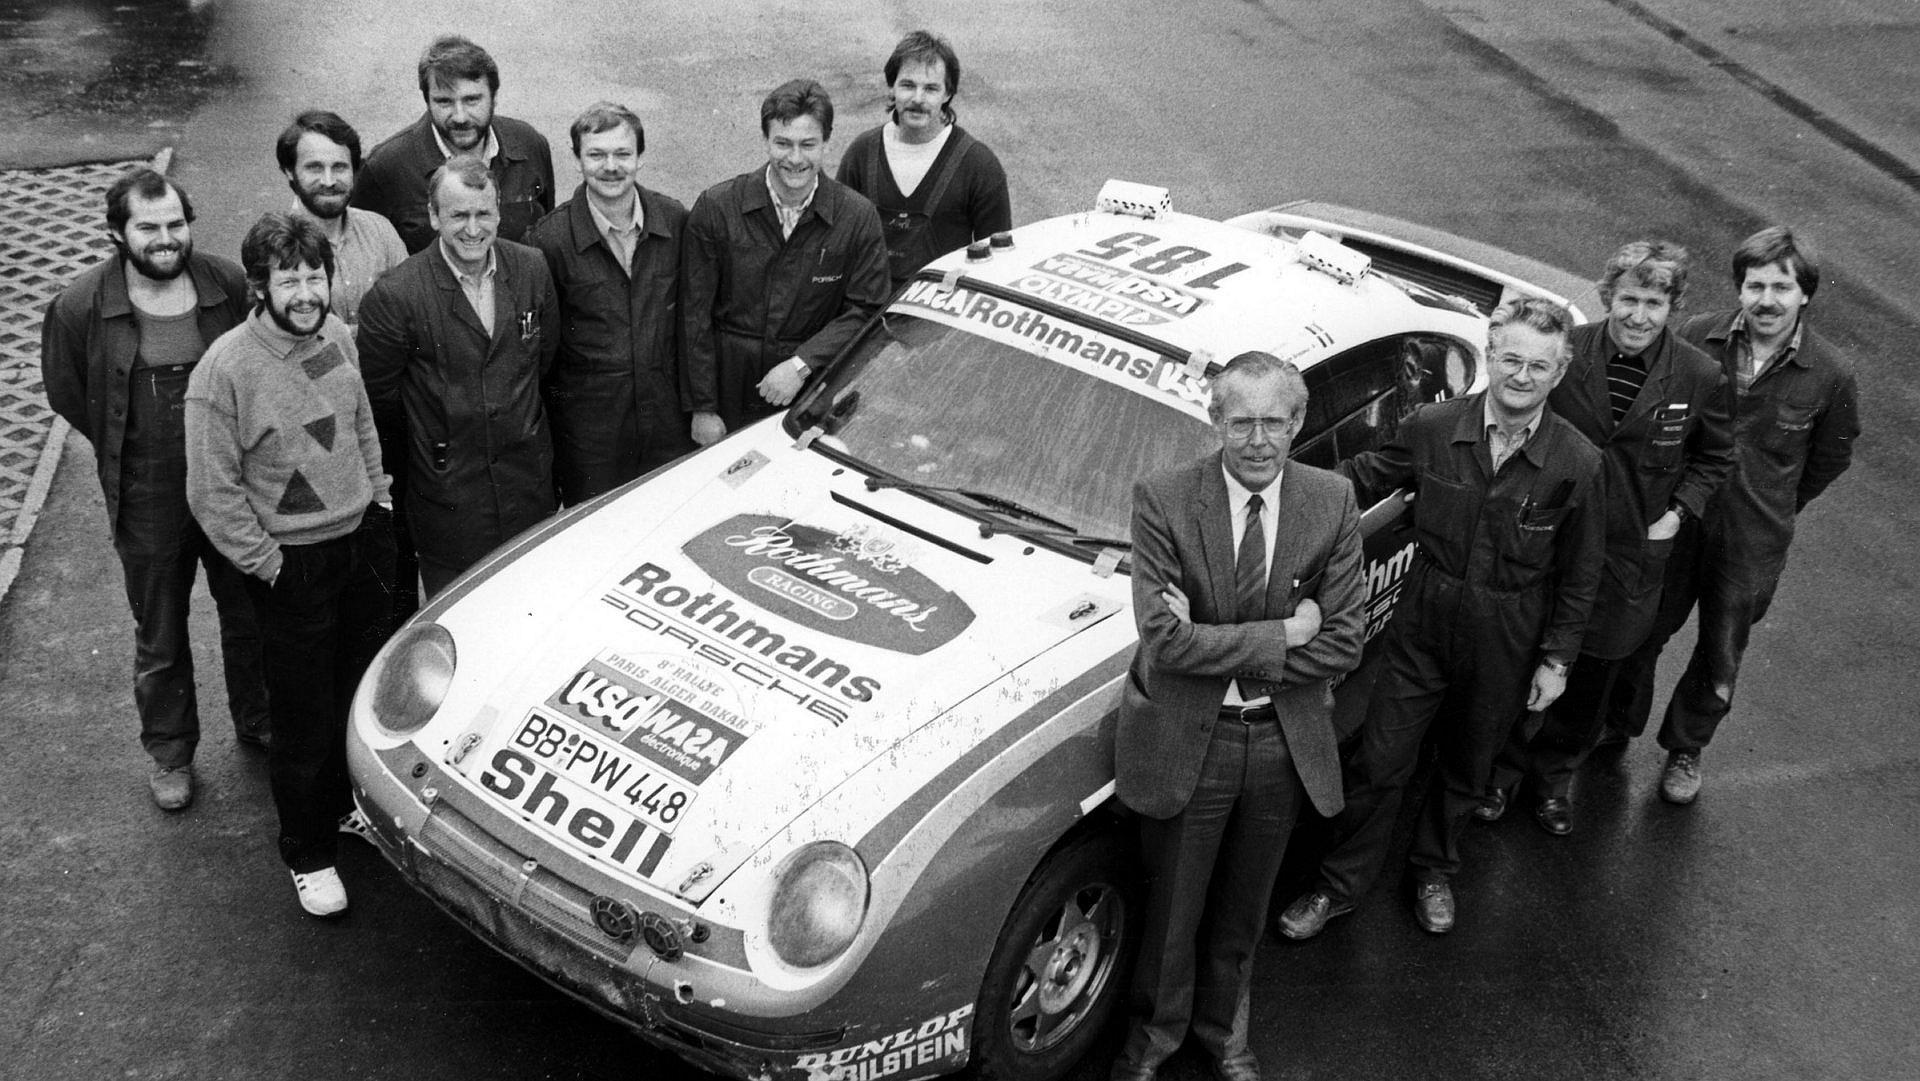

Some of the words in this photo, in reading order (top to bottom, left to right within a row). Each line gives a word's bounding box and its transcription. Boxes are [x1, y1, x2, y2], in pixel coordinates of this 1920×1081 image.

[1076, 232, 1251, 290] 185
[1019, 275, 1151, 323] OLYMPIA
[966, 293, 1154, 379] Rothmans
[725, 519, 938, 632] Rothmans
[765, 574, 840, 611] RACING
[601, 594, 849, 727] PORSCHE
[619, 562, 881, 702] Rothmans
[606, 654, 649, 679] PARIS
[651, 677, 697, 704] ALGER
[700, 701, 750, 731] DAKAR
[672, 664, 726, 698] RALLYE
[480, 749, 674, 879] Shell
[624, 773, 687, 824] 448
[791, 1002, 975, 1069] DUNLOP
